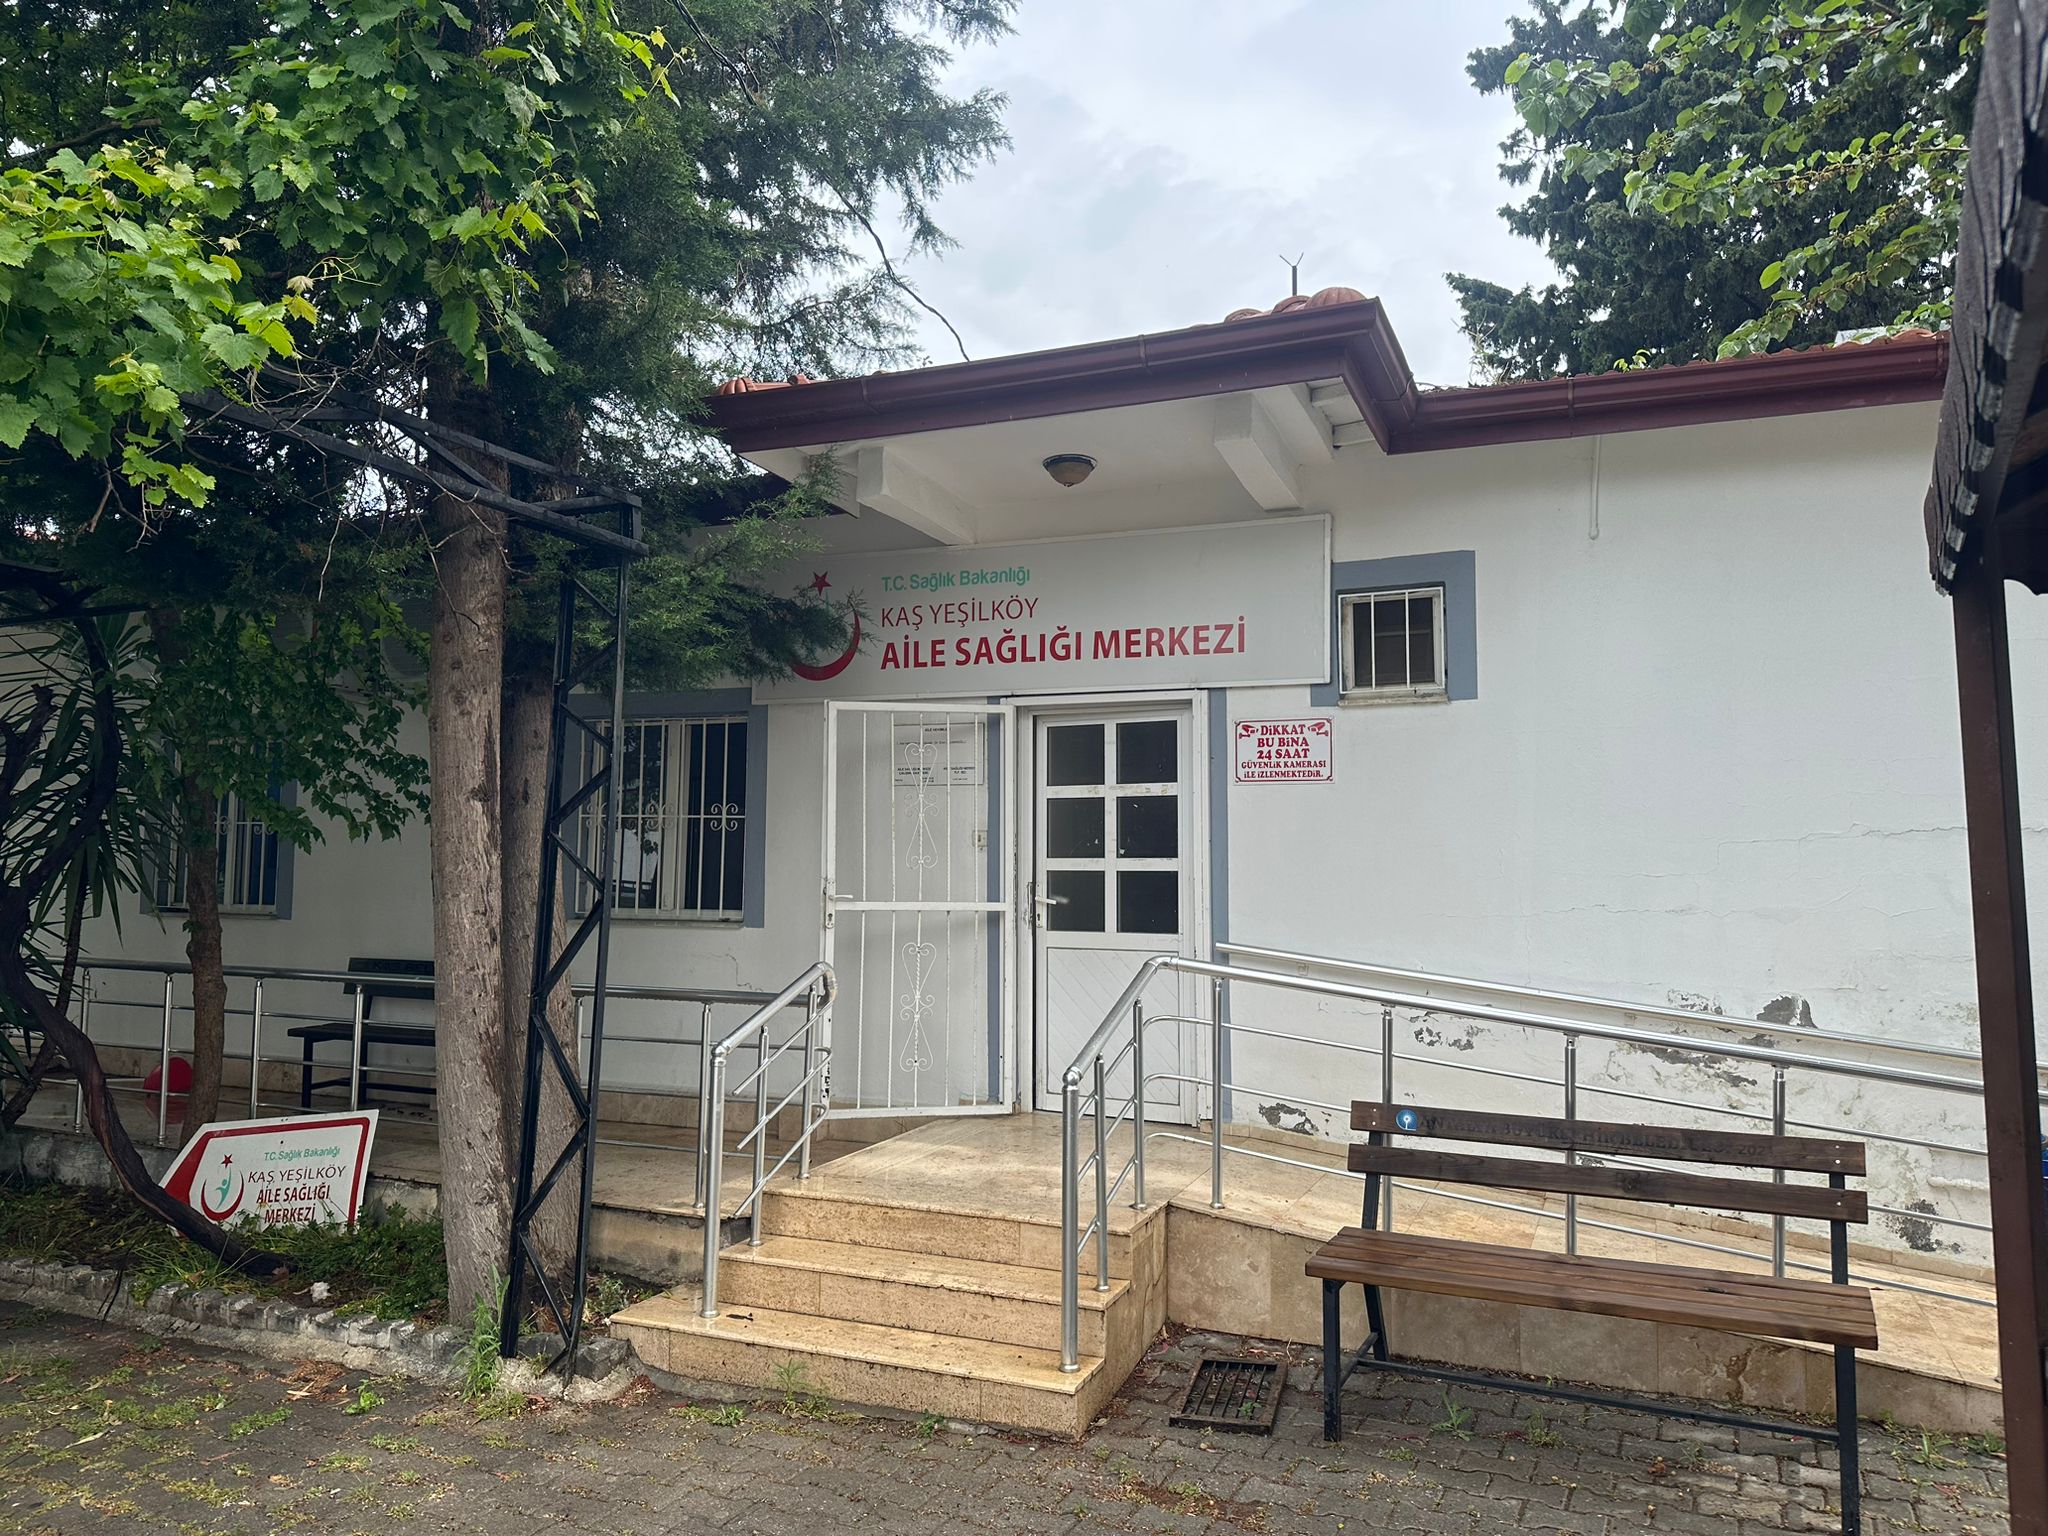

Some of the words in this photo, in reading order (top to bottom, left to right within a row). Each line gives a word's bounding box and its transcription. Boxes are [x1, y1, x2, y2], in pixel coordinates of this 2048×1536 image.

[881, 576, 907, 592] T.C.
[910, 572, 955, 592] Sağlık
[959, 567, 1030, 586] Bakanlığı
[881, 605, 923, 631] KAŞ
[929, 595, 1039, 628] YEŞİLKÖY
[880, 634, 946, 670] AİLE
[955, 625, 1082, 666] SAĞLIĞI
[1092, 615, 1245, 660] MERKEZİ
[1257, 737, 1275, 748] BU
[1257, 749, 1272, 760] 24
[1274, 748, 1310, 759] SAAT
[1283, 760, 1326, 769] KAMERASI
[278, 1150, 302, 1161] Sağlık
[303, 1146, 340, 1158] Bakanlığı
[248, 1170, 275, 1185] KAŞ
[279, 1164, 347, 1183] YEŞİLKÖY
[256, 1185, 281, 1203] AİLE
[283, 1182, 330, 1202] SAĞLIĞI
[264, 1203, 316, 1224] MERKEZİ
